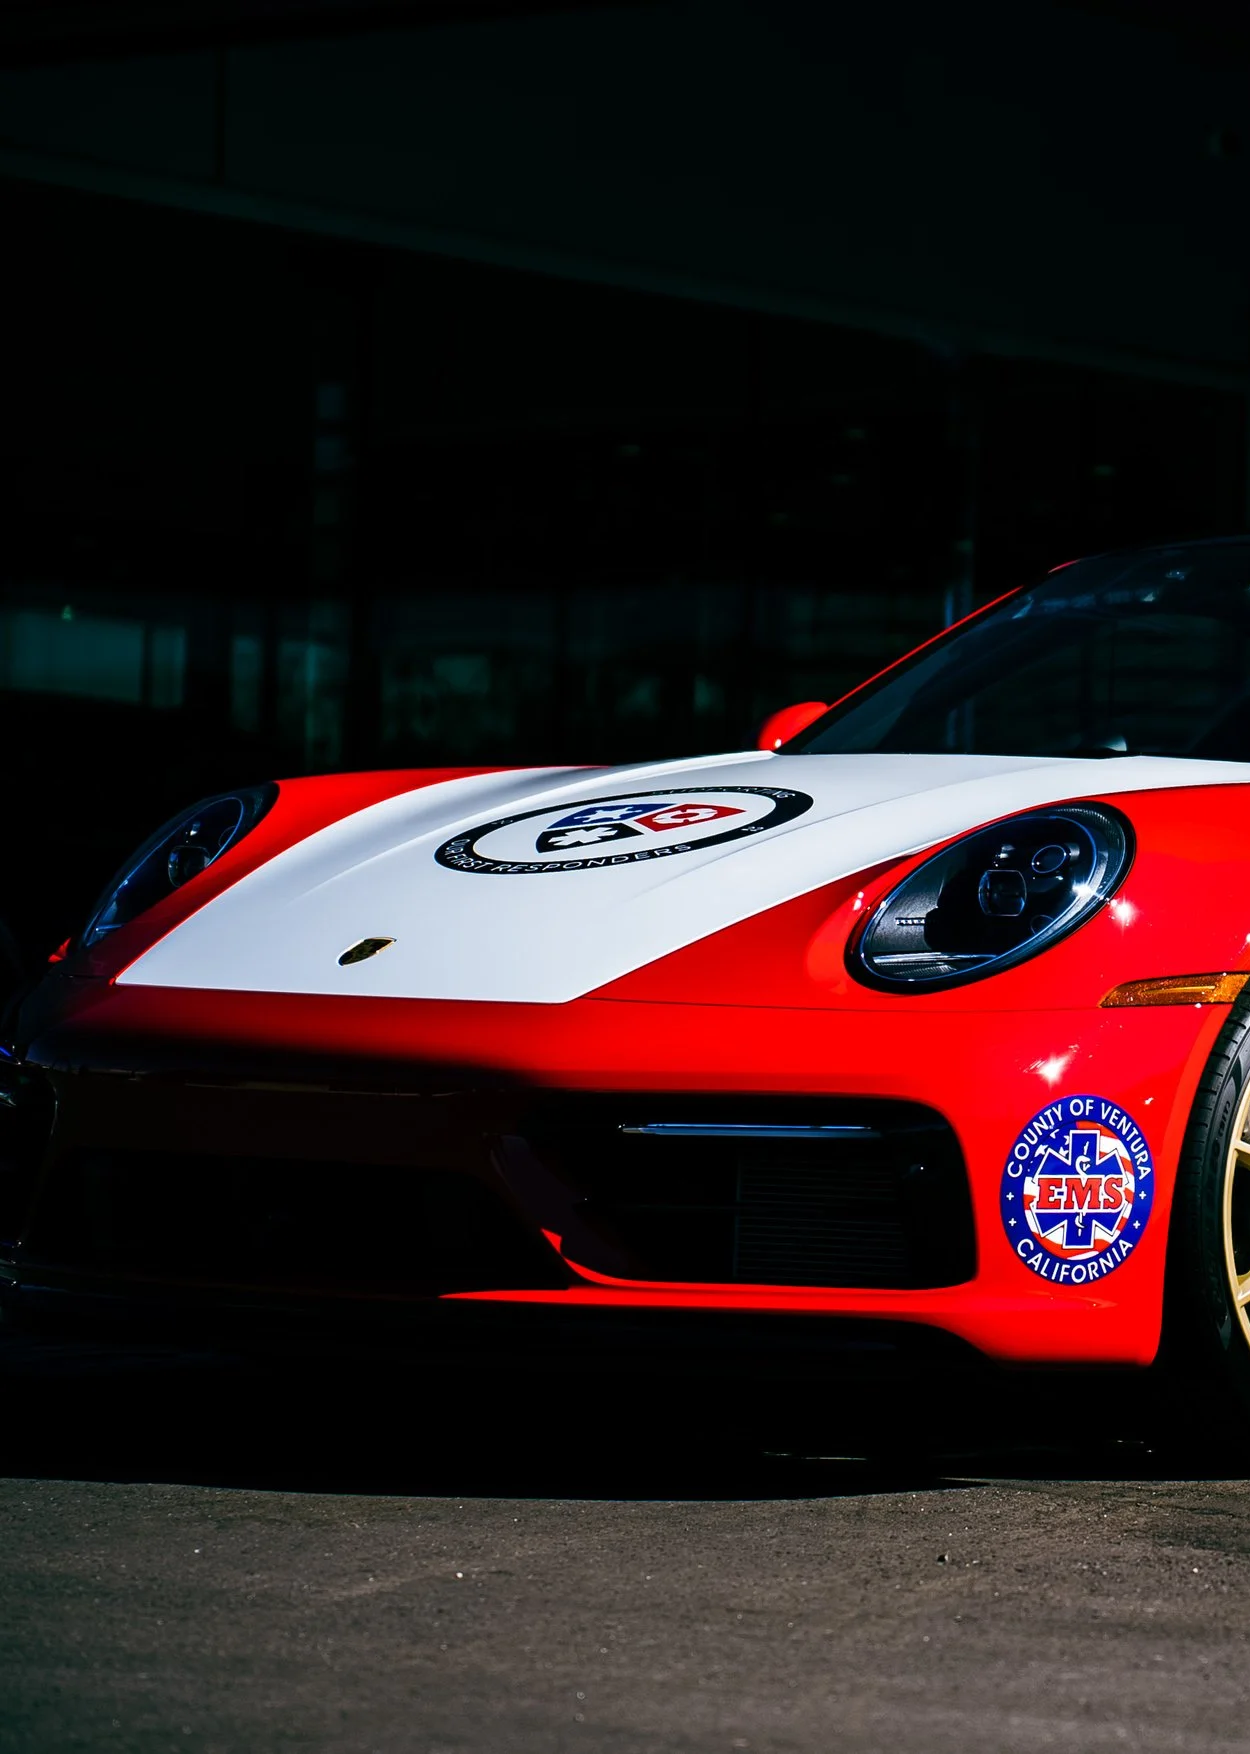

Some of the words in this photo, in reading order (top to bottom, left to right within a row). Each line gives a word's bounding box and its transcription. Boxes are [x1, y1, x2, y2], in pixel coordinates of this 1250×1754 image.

[448, 851, 488, 871] FIRST
[489, 844, 693, 873] RESPONDERS
[1007, 1103, 1063, 1179] COUNTY
[1069, 1098, 1095, 1117] OF
[1101, 1102, 1152, 1181] VENTURA
[1036, 1177, 1124, 1210] EMS
[1017, 1238, 1134, 1284] CALIFORNIA
